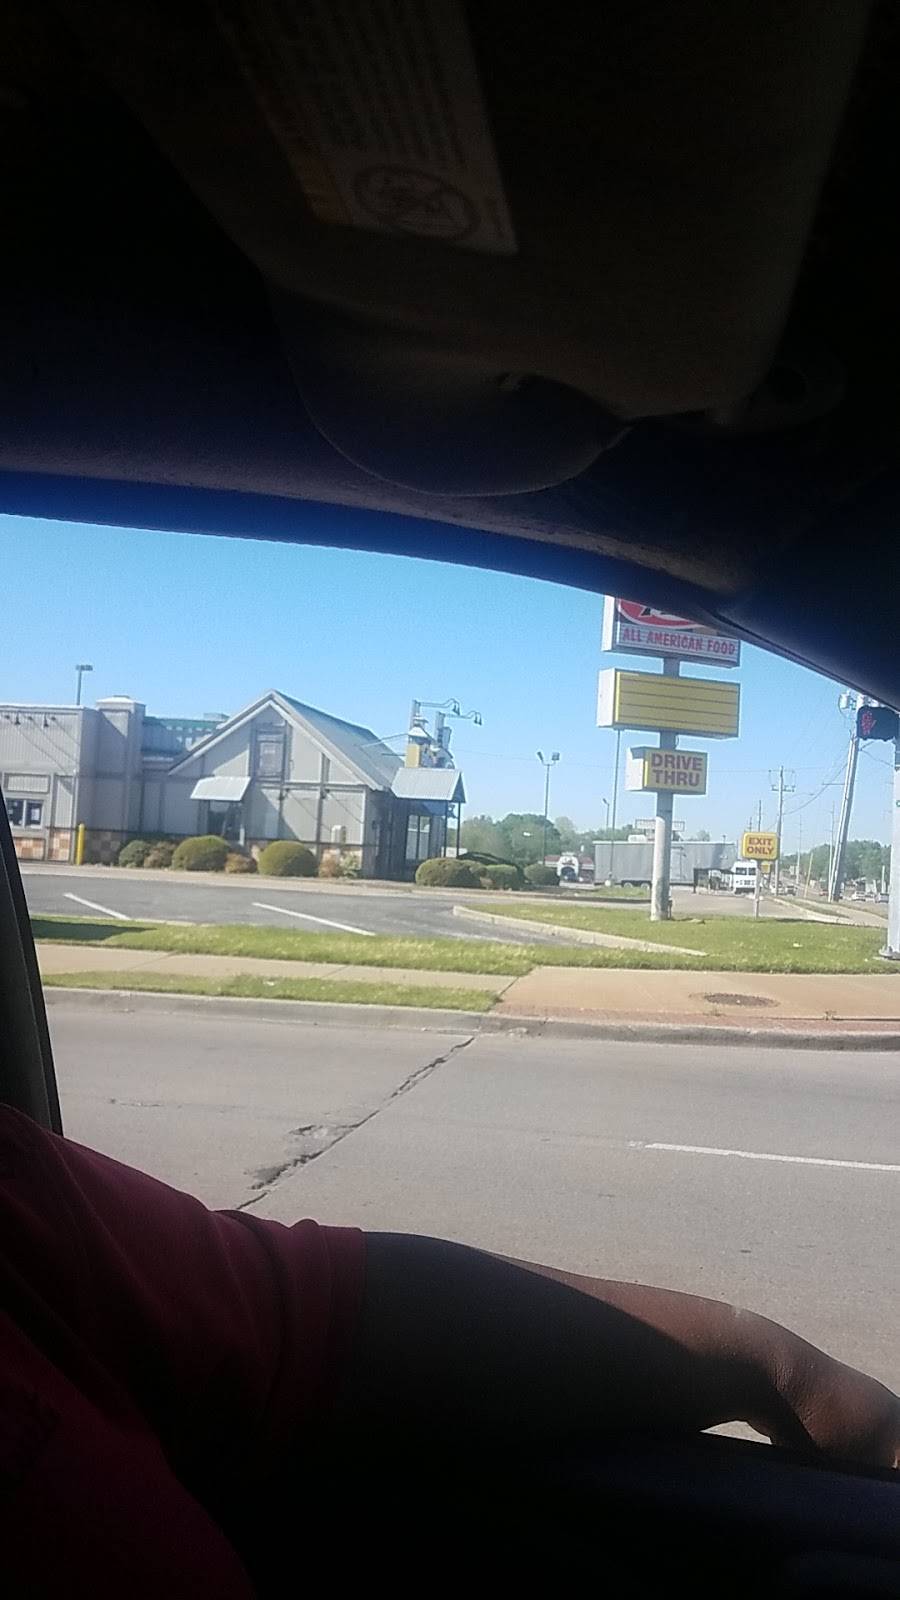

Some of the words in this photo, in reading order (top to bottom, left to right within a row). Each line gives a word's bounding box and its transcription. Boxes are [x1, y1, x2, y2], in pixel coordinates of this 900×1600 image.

[623, 629, 641, 642] ALL
[648, 631, 703, 651] AMERICAN
[707, 640, 736, 655] FOOD
[651, 753, 703, 771] DRIVE
[653, 770, 700, 786] THRU
[749, 837, 773, 845] EXIT
[747, 846, 774, 855] ONLY
